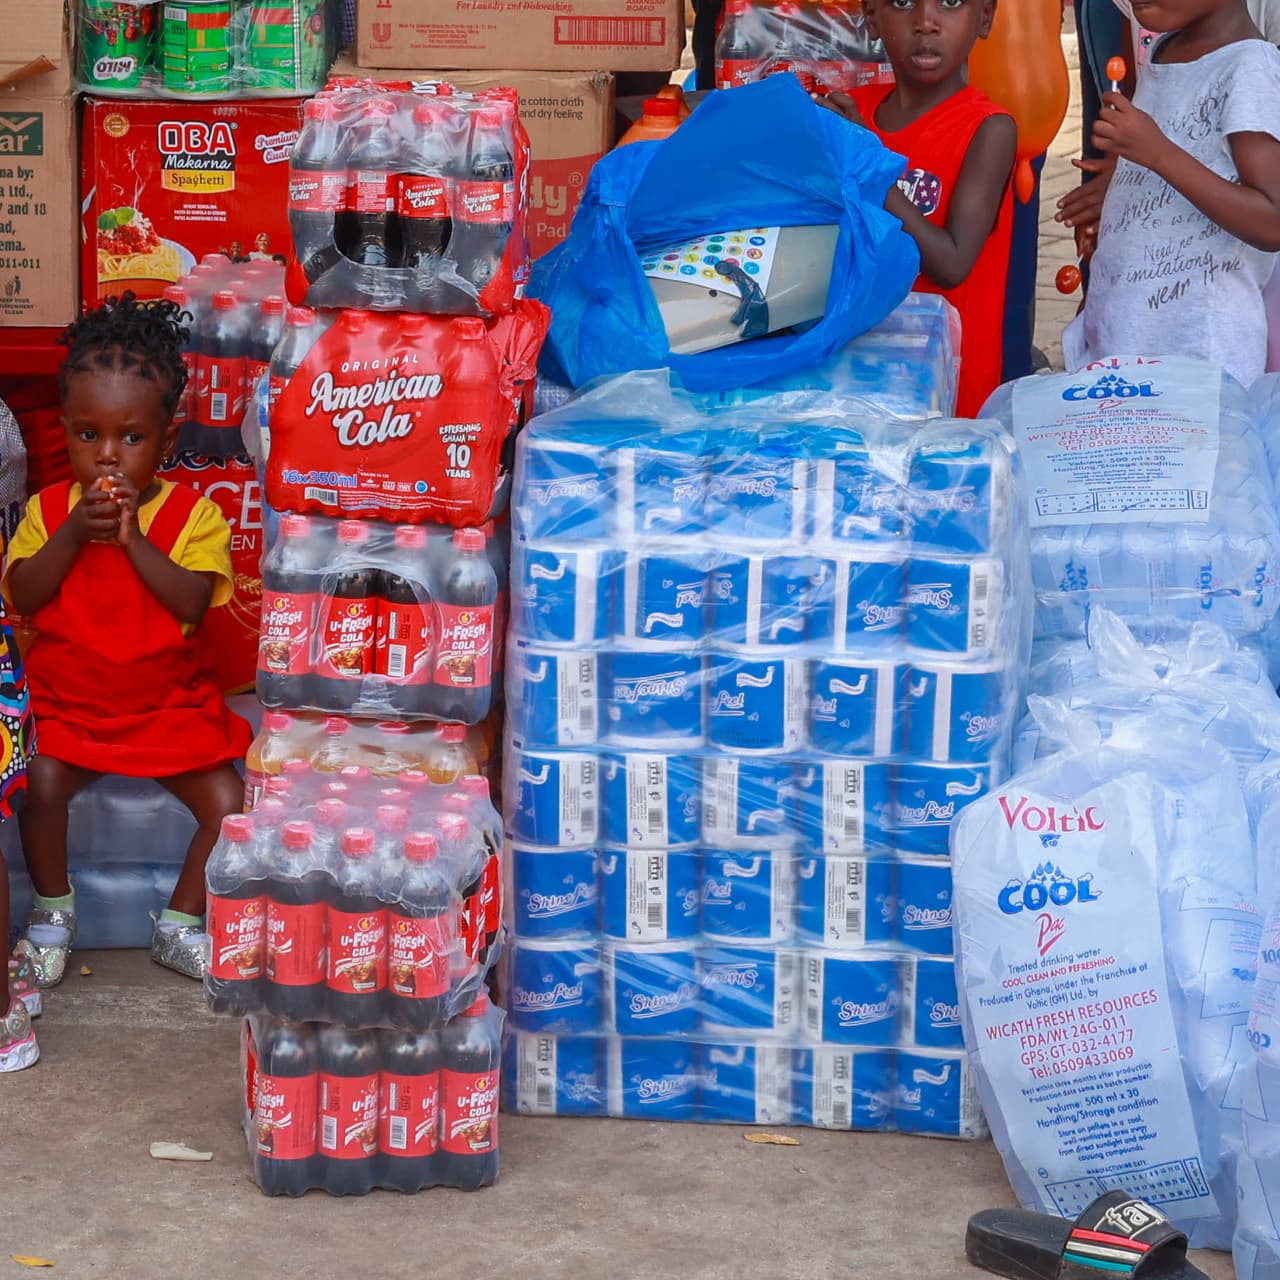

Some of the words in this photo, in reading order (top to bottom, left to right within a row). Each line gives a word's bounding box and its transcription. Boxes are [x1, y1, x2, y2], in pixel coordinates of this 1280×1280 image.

[456, 0, 470, 11] For
[471, 0, 504, 13] Laundry
[506, 1, 521, 11] and
[96, 57, 132, 74] MILO
[528, 96, 559, 106] cotton
[560, 96, 584, 107] cloth
[537, 108, 553, 120] dry
[553, 108, 584, 121] feeling
[158, 121, 237, 156] OBA
[255, 131, 299, 150] Premium
[163, 154, 233, 170] Makarna
[17, 165, 35, 181] by:
[171, 172, 225, 188] Spaghetti
[8, 184, 34, 200] Ltd.,
[404, 186, 444, 200] American
[462, 191, 500, 206] American
[7, 202, 29, 216] and
[33, 203, 48, 216] 18
[411, 196, 436, 208] Cola
[468, 202, 493, 214] Cola
[536, 222, 566, 238] Pad
[1144, 244, 1175, 261] Need
[1148, 277, 1191, 310] wear
[340, 354, 420, 373] ORIGINAL
[305, 370, 444, 416] American
[1061, 380, 1163, 402] COOL
[332, 404, 413, 446] Cola
[439, 423, 481, 435] REFRESHING
[442, 432, 467, 443] GHANA
[446, 443, 471, 469] 10
[282, 469, 358, 489] 16x350ml
[445, 468, 472, 479] YEARS
[268, 626, 290, 636] COLA
[340, 631, 364, 643] COLA
[451, 640, 475, 650] COLA
[998, 795, 1105, 833] Voltic
[997, 872, 1103, 915] COOL
[238, 931, 260, 943] COLA
[351, 945, 376, 958] COLA
[393, 949, 414, 960] COLA
[1008, 959, 1038, 975] Treated
[1040, 954, 1075, 969] drinking
[1076, 948, 1102, 961] water
[985, 1019, 1034, 1041] WICATH
[1036, 1009, 1076, 1028] FRESH
[1078, 988, 1158, 1019] RESOURCES
[1029, 1065, 1053, 1080] Tel:
[1053, 1046, 1134, 1075] 0509433069
[469, 1106, 491, 1117] COLA
[1046, 1100, 1084, 1115] Volume:
[1084, 1095, 1104, 1107] 500
[1117, 1096, 1159, 1113] condition
